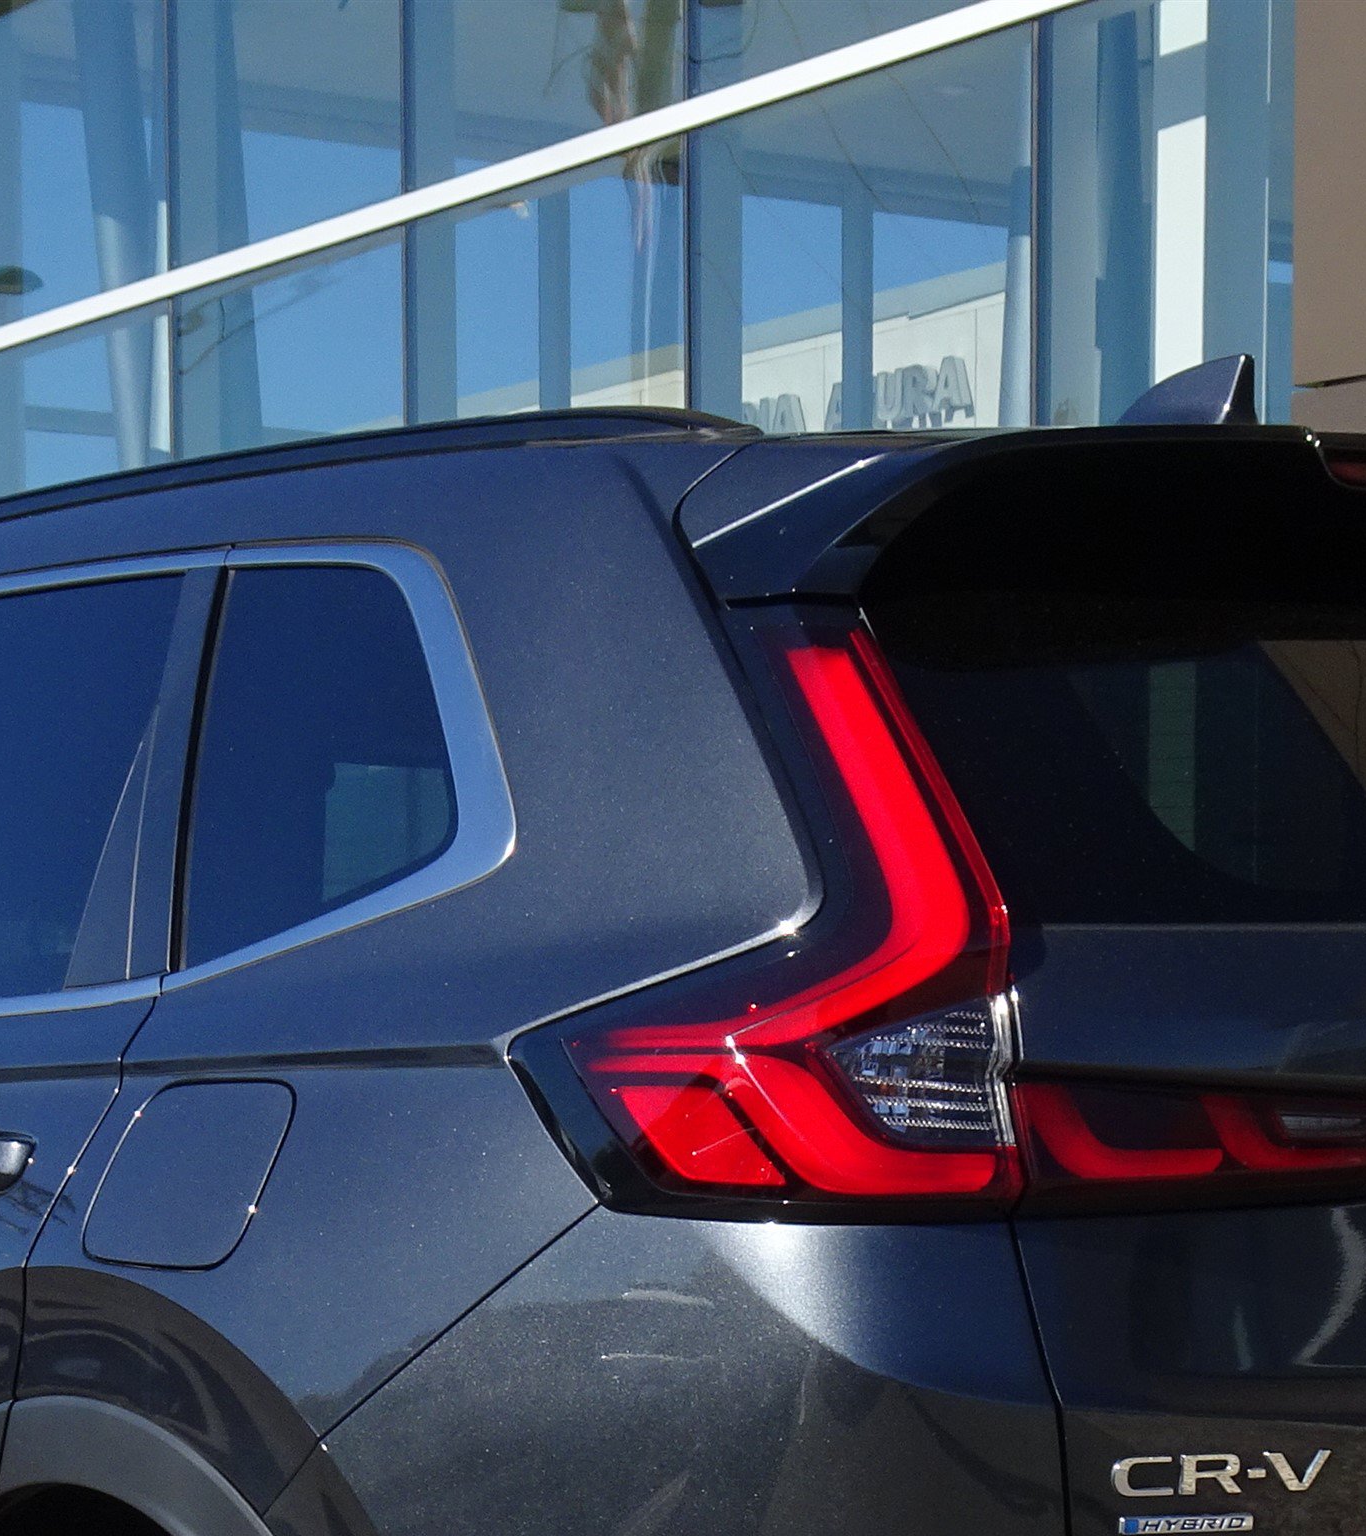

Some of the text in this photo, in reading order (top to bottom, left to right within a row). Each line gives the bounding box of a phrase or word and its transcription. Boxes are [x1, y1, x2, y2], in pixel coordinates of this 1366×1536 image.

[824, 356, 975, 428] AURA
[1111, 1449, 1332, 1498] CR-V
[1142, 1516, 1245, 1532] HYBRID
